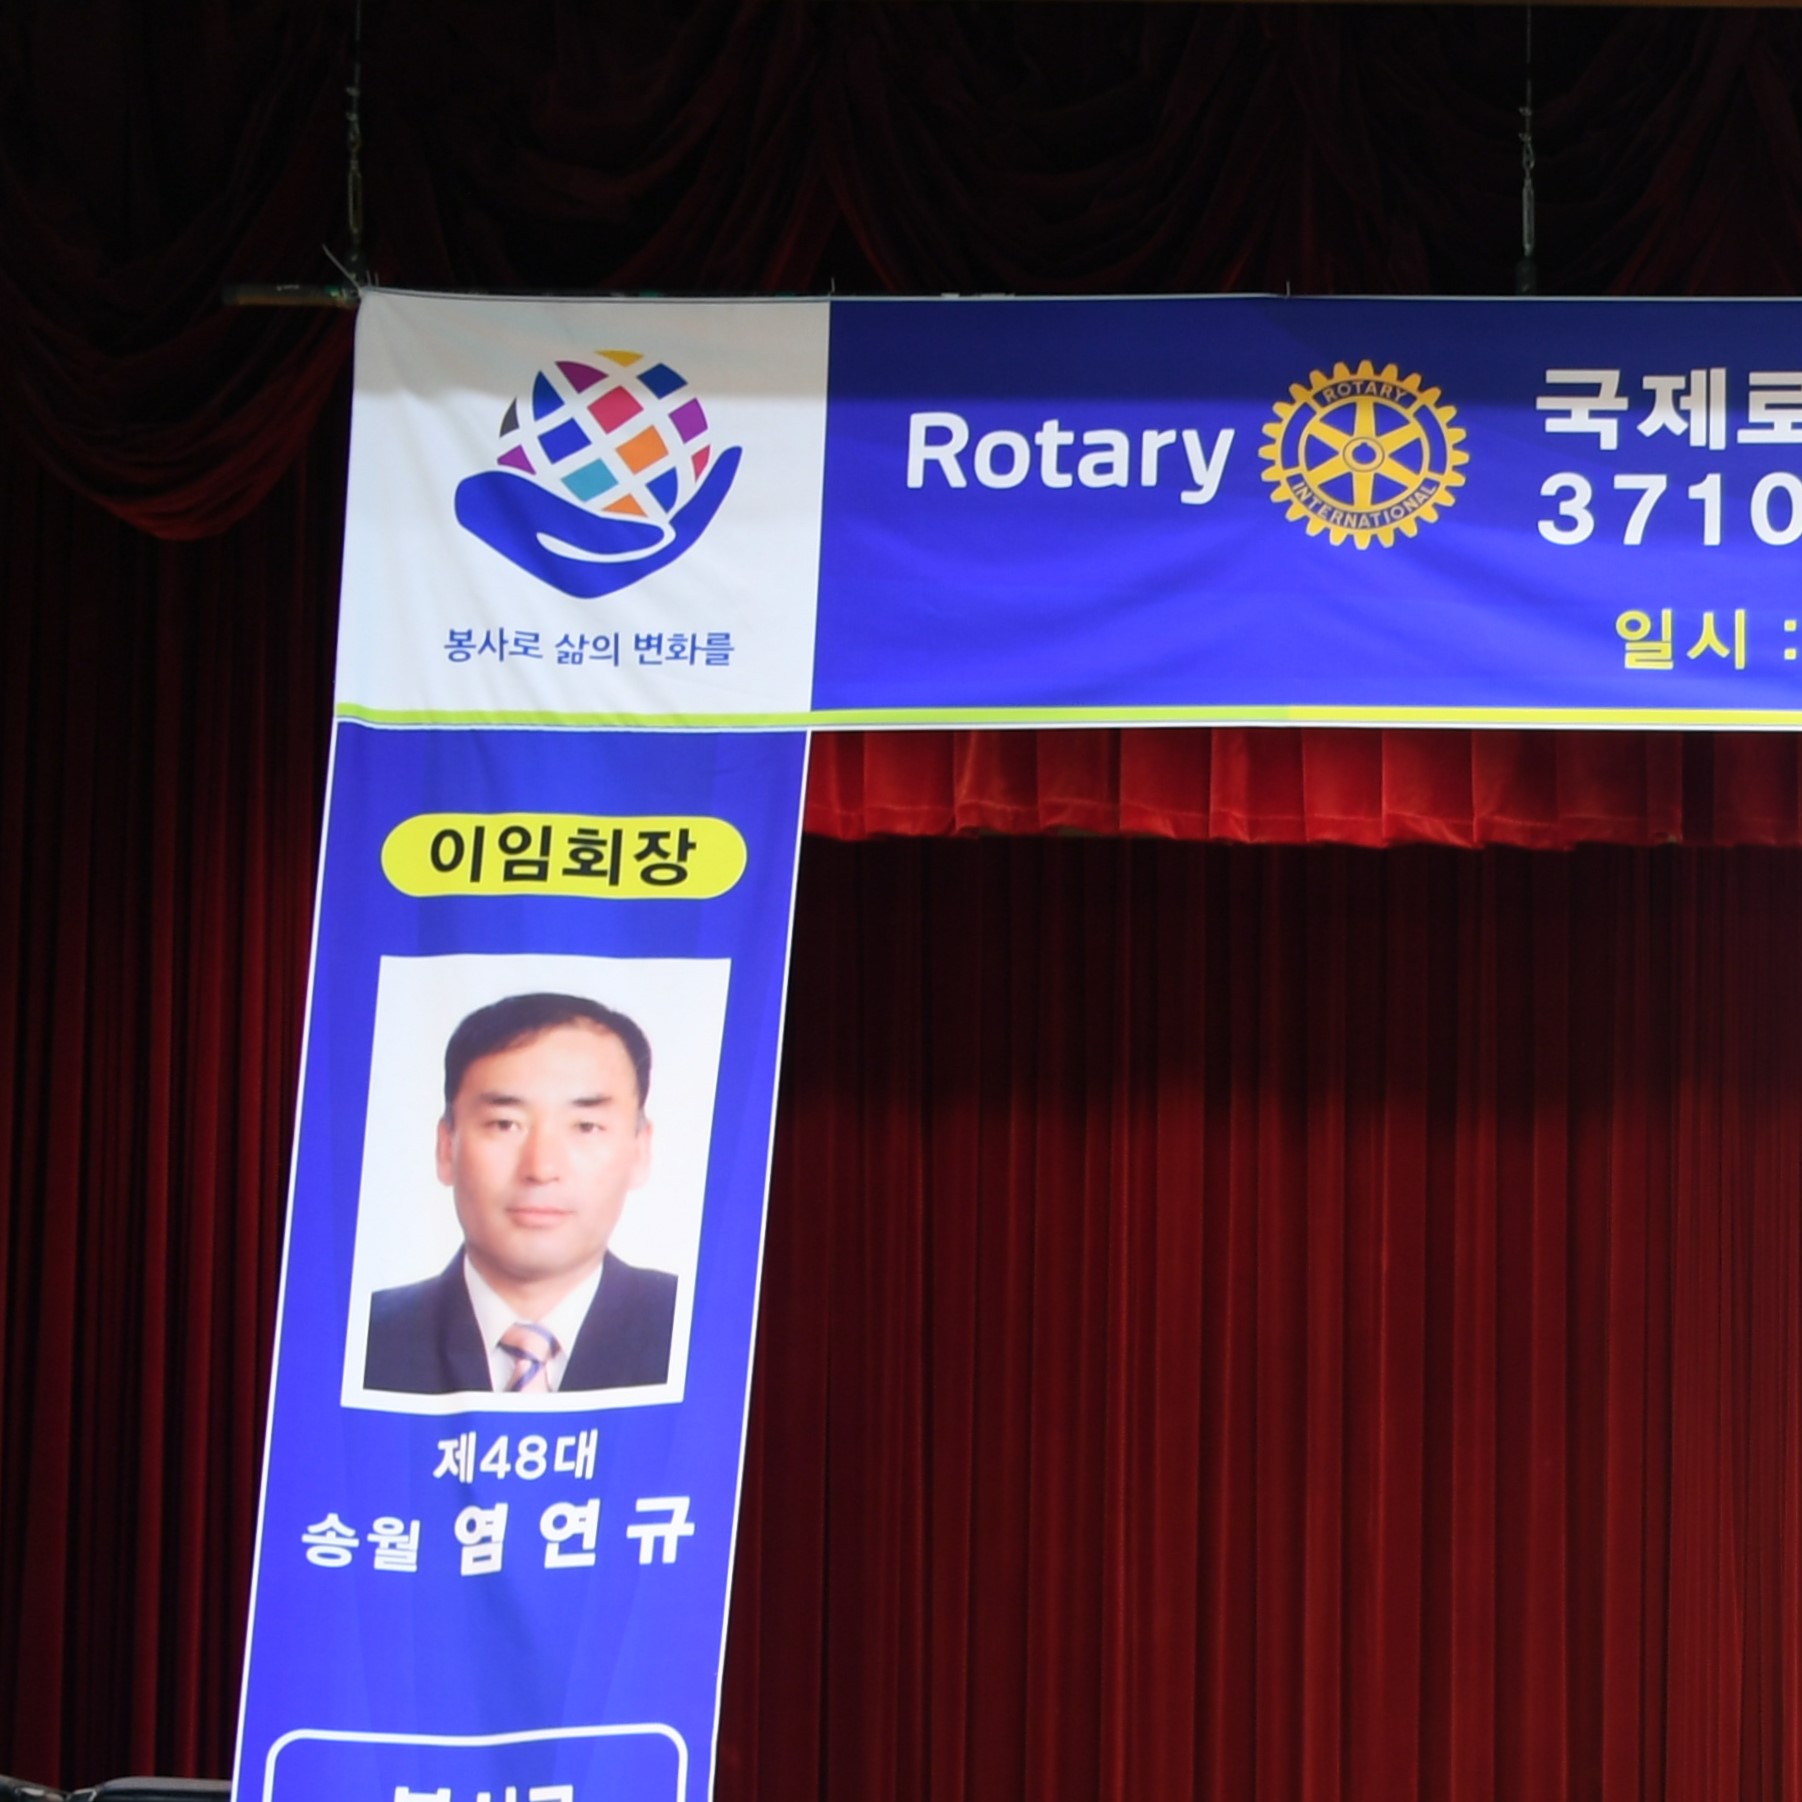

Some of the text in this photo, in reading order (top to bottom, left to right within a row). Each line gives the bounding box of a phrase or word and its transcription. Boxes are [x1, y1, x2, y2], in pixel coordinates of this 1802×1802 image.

[1321, 379, 1407, 405] ROTARY
[905, 410, 1236, 506] Rotary
[1290, 480, 1437, 530] INTERNATIONAL
[443, 626, 736, 669] 봉사로 삶의 변화를
[1614, 608, 1748, 671] 일시
[429, 827, 699, 888] 이임회장
[433, 1429, 597, 1485] 제48대
[301, 1515, 421, 1573] 송월
